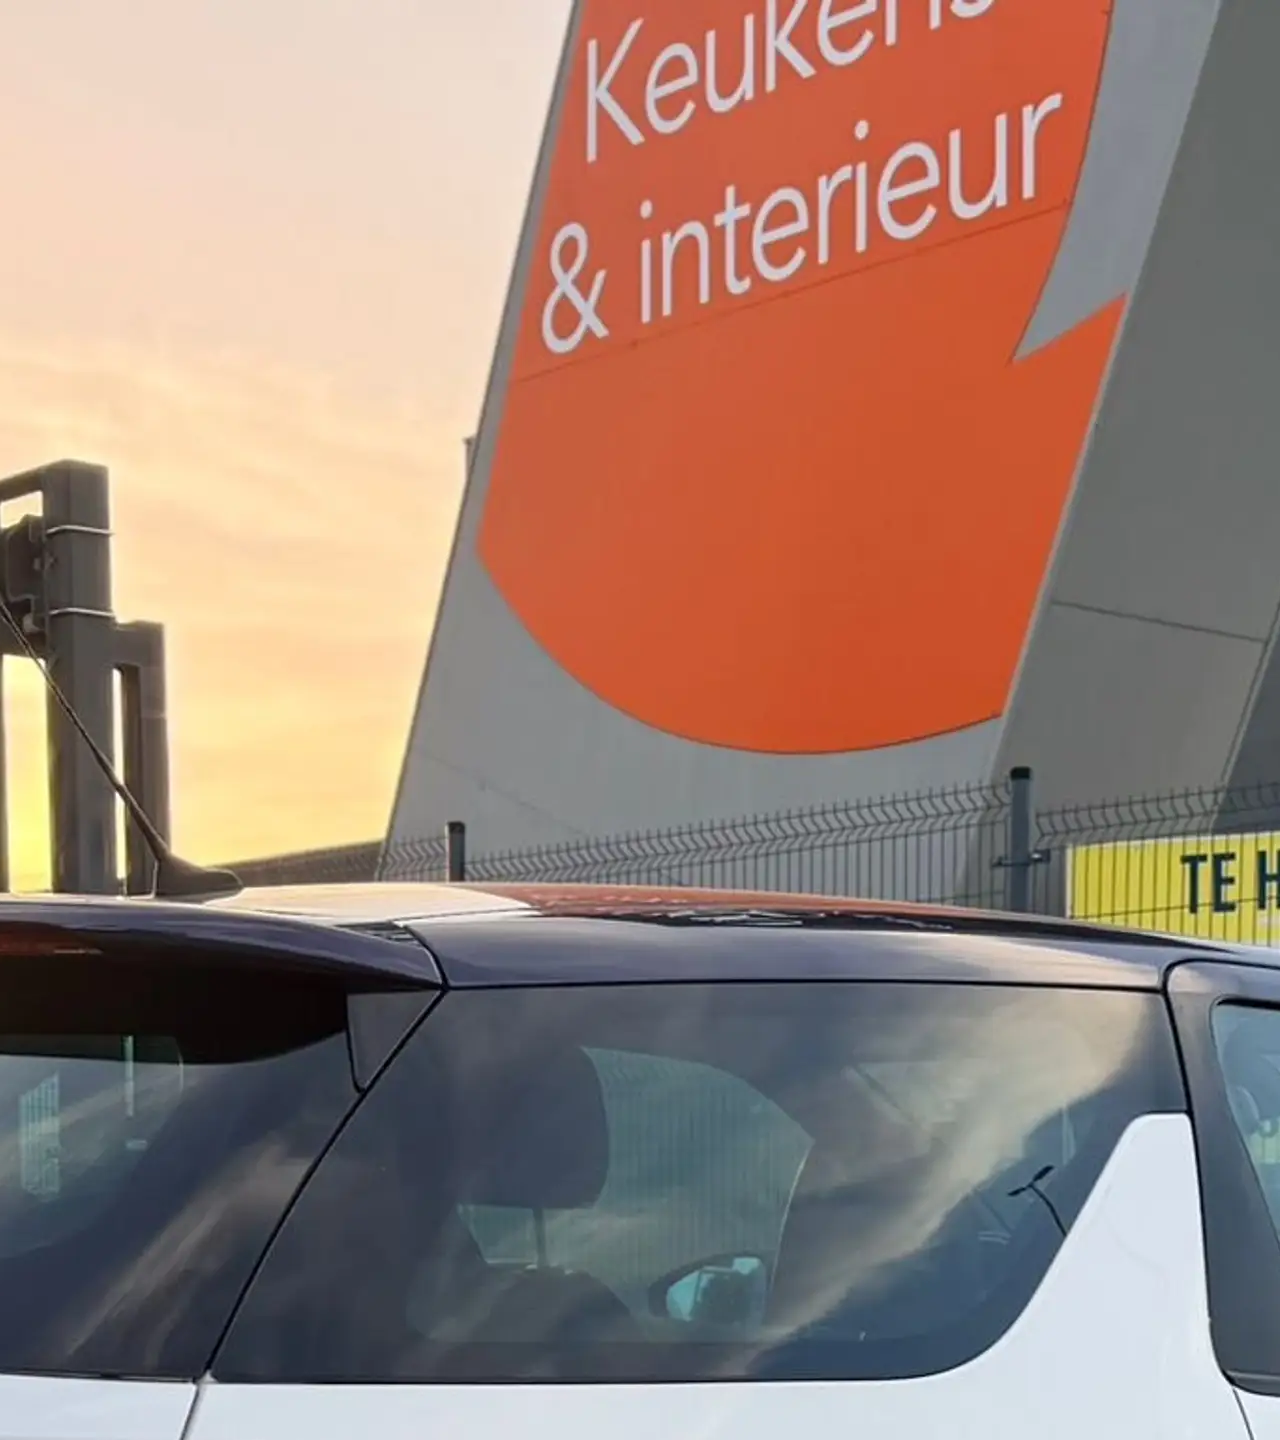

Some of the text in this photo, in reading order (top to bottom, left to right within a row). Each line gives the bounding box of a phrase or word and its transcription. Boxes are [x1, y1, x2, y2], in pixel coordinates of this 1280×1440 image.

[586, 0, 998, 163] Keuke
[541, 92, 1063, 354] & interieur
[1180, 852, 1237, 914] TE
